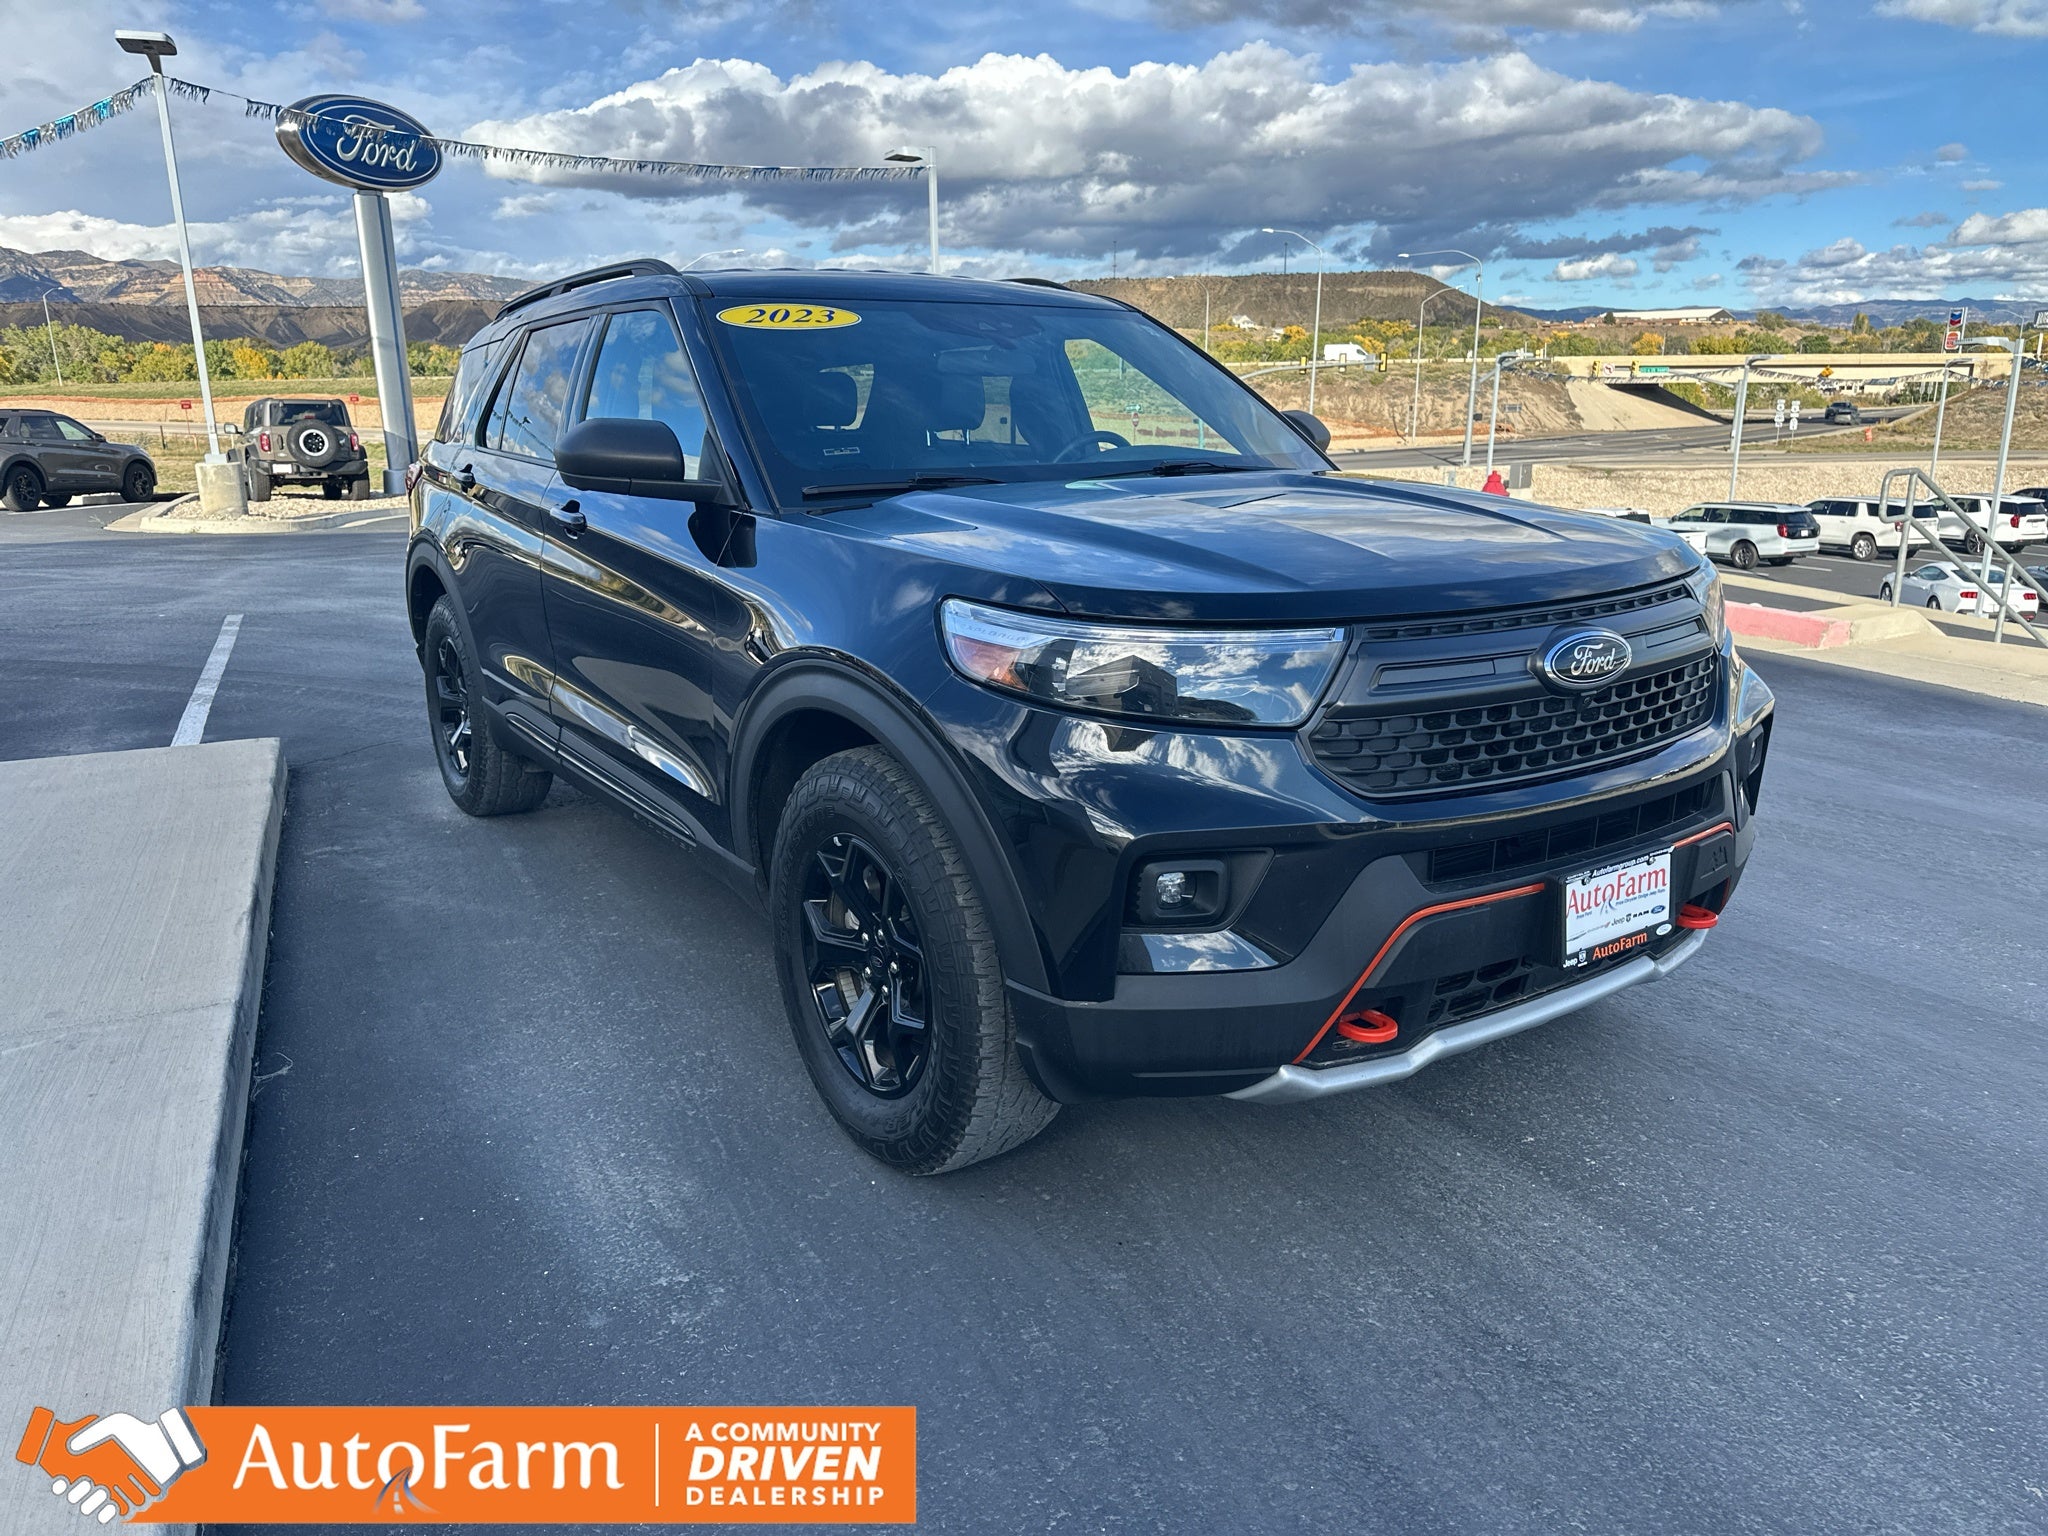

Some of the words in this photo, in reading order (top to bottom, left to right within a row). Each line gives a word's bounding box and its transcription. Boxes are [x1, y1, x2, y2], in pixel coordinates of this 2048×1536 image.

[337, 114, 417, 172] Ford
[744, 308, 836, 324] 2023
[1571, 643, 1617, 676] Ford
[1566, 867, 1668, 918] AutoFarm
[1592, 932, 1648, 960] AutoFarm
[1563, 958, 1578, 968] Jeep
